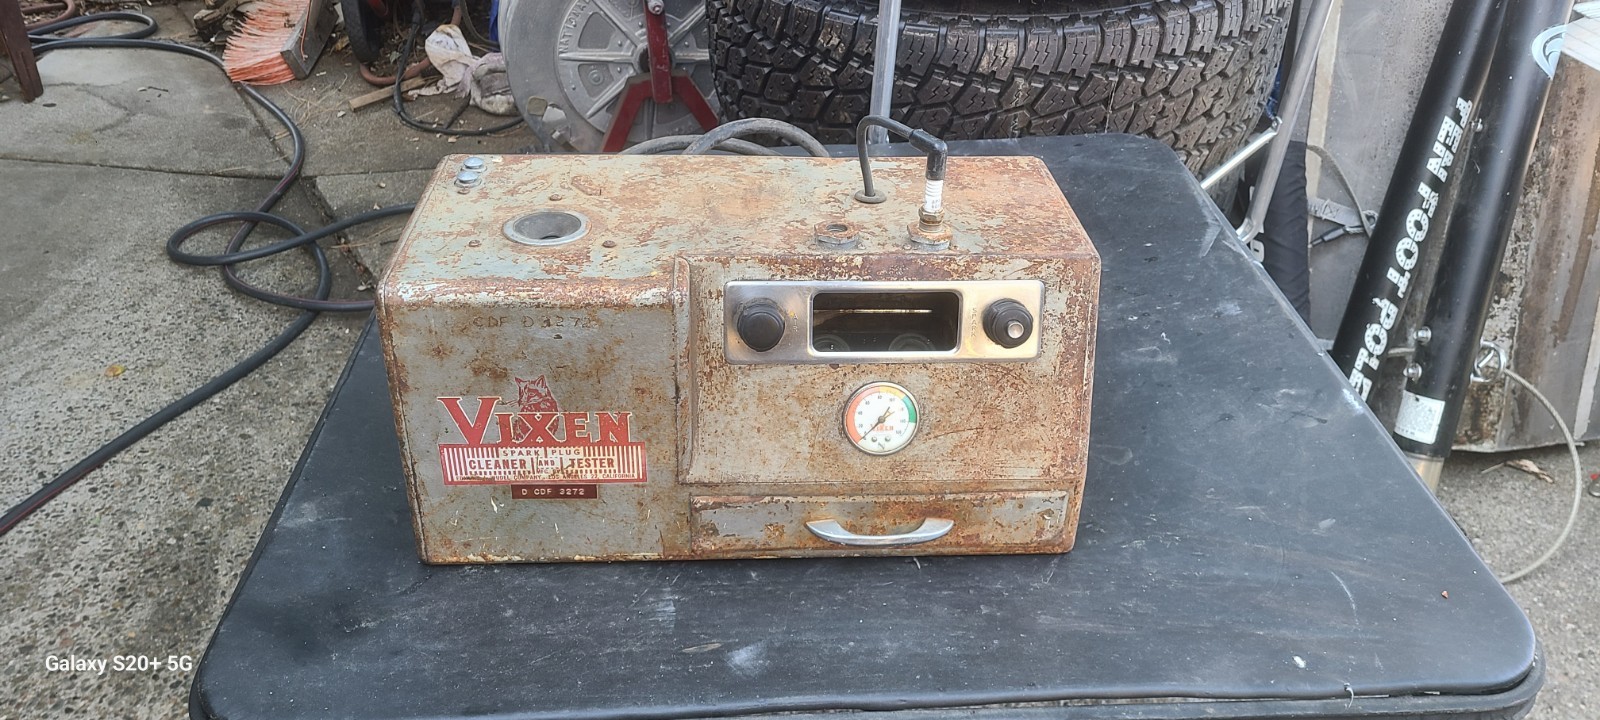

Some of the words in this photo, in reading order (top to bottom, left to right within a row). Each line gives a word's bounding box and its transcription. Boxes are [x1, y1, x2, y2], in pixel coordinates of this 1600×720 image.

[1426, 97, 1473, 183] TEN
[1387, 181, 1439, 299] FOOT
[1349, 298, 1399, 402] POLE
[437, 396, 632, 445] VIXEN
[468, 457, 527, 470] CLEANER
[538, 459, 555, 467] AND
[569, 458, 615, 468] TESTER
[502, 449, 540, 457] SPARK
[521, 488, 528, 496] D
[534, 488, 553, 496] CDF
[559, 488, 585, 496] 3272
